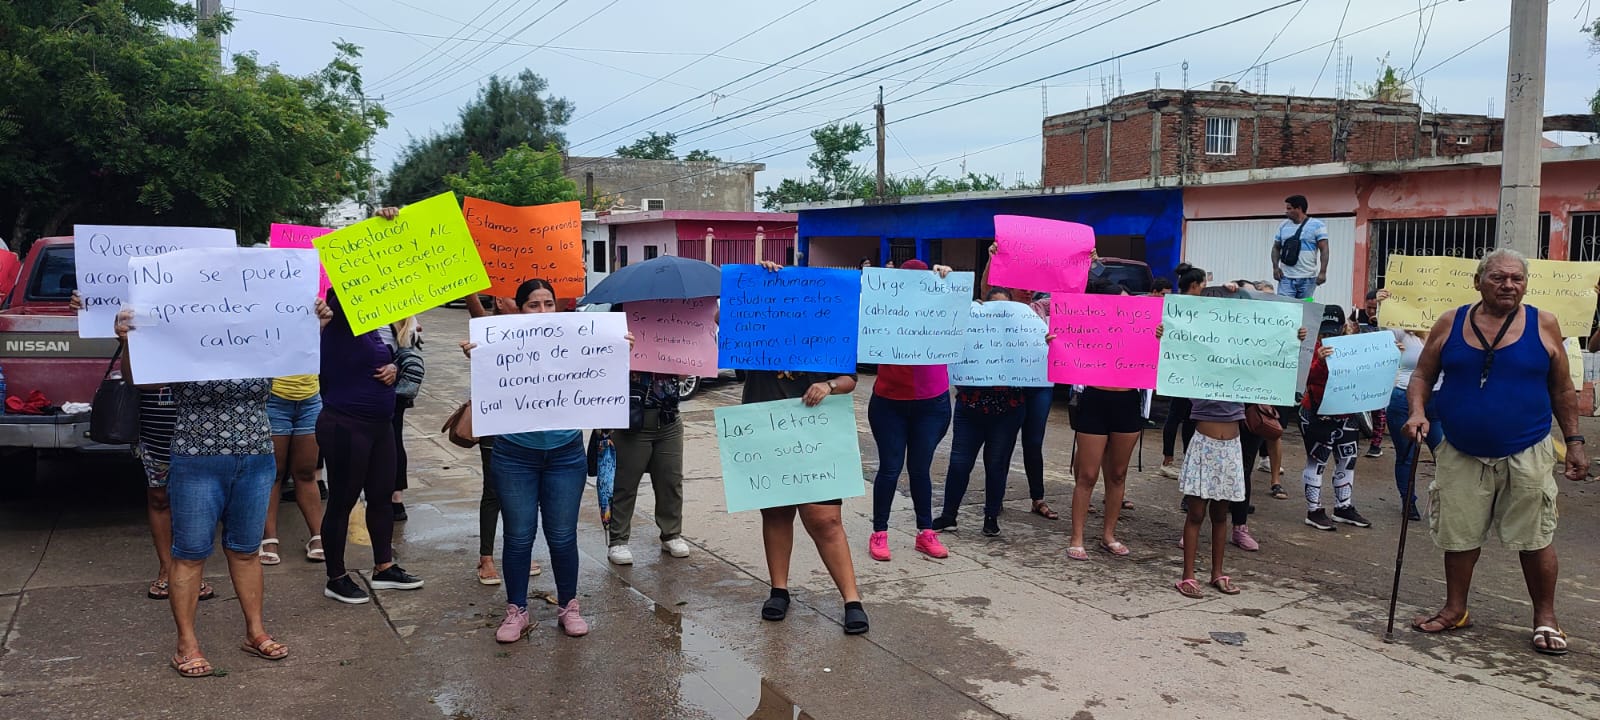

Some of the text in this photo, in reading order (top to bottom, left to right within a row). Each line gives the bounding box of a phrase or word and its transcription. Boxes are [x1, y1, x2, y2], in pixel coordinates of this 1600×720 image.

[466, 207, 579, 239] Estamos esperando
[489, 242, 534, 258] apoyos
[545, 244, 554, 252] a
[560, 240, 575, 251] los
[200, 269, 222, 283] se
[242, 260, 302, 292] puede
[341, 244, 446, 294] para la escuela
[531, 262, 558, 276] que
[1389, 261, 1403, 274] El
[1553, 270, 1583, 283] hijos
[350, 294, 364, 307] de
[370, 271, 422, 297] nuestros
[737, 272, 826, 289] Es inhumano
[867, 273, 905, 297] Urge
[1390, 278, 1414, 287] nado
[1422, 279, 1439, 287] NO
[85, 296, 121, 312] para
[357, 273, 480, 325] Gral Vicente Guerrero
[729, 291, 843, 306] estudiar en estas
[275, 301, 310, 316] con
[633, 311, 647, 322] Se
[730, 305, 832, 320] circunstancias de
[1054, 302, 1152, 325] Nuestros hijos
[1167, 303, 1199, 324] Urge
[914, 309, 947, 318] nuevo
[952, 310, 959, 327] y
[486, 319, 594, 350] Exigimos el
[862, 325, 964, 336] aires acondicionados
[1053, 323, 1101, 334] estudian
[1108, 326, 1123, 334] en
[6, 341, 70, 352] NISSAN
[784, 334, 797, 346] el
[801, 335, 837, 350] apoyo
[842, 336, 850, 344] a
[973, 341, 985, 350] de
[990, 339, 1003, 348] las
[1005, 339, 1029, 348] aulas
[1168, 329, 1221, 344] cableado
[1228, 337, 1268, 348] nuevo
[1276, 340, 1286, 356] y
[496, 345, 614, 371] apoyo de aires
[891, 346, 922, 360] Vicente
[926, 347, 959, 360] Guerrero
[1163, 351, 1298, 369] aires acondicionados
[1073, 357, 1107, 369] Vicente
[1115, 357, 1157, 370] Guerrero
[498, 367, 607, 388] acondicionados
[952, 373, 963, 382] No
[1191, 376, 1224, 390] Vicente
[1232, 377, 1273, 393] Guerrero
[480, 389, 626, 415] Gral Vicente Guerrero
[723, 412, 829, 438] Las letras
[733, 440, 824, 463] con sudor
[749, 463, 837, 490] NO ENTRAN
